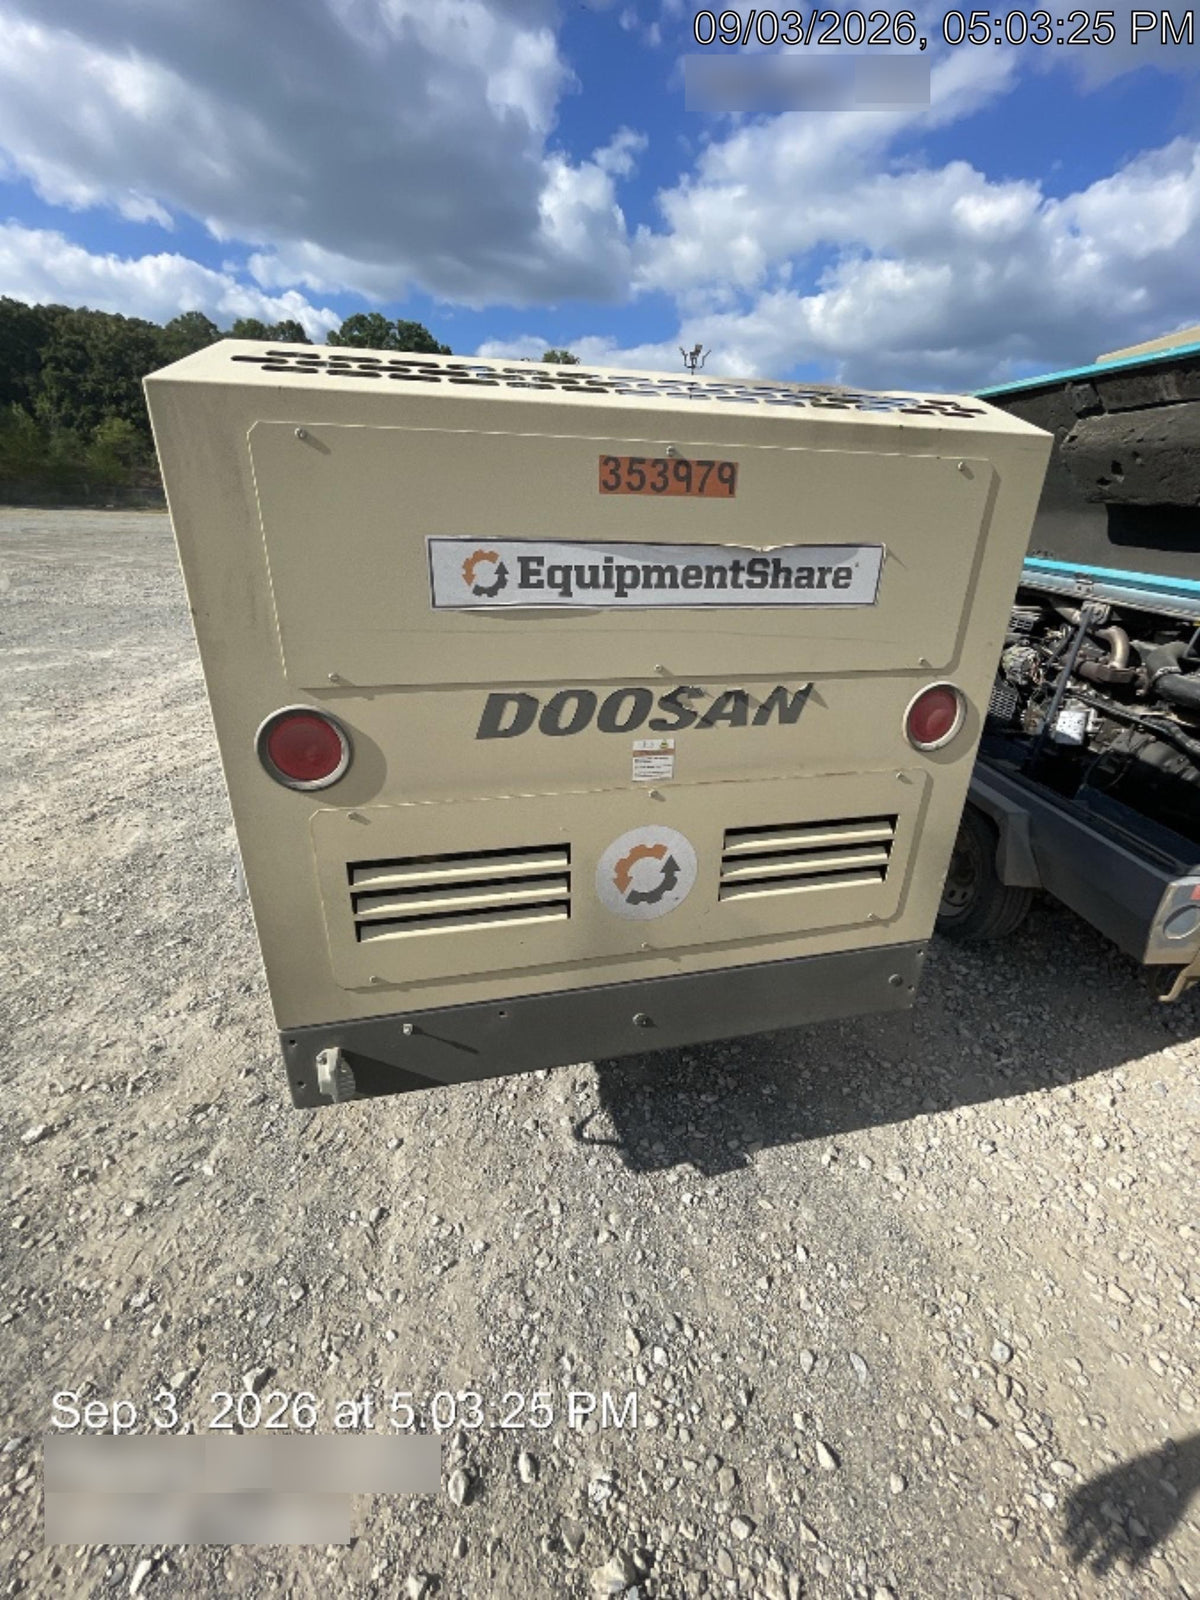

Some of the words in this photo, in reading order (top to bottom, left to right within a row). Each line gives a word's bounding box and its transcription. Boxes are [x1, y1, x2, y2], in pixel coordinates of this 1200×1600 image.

[602, 455, 737, 495] 353979
[516, 556, 853, 598] EquipmentShare
[475, 682, 815, 740] DOOSAN
